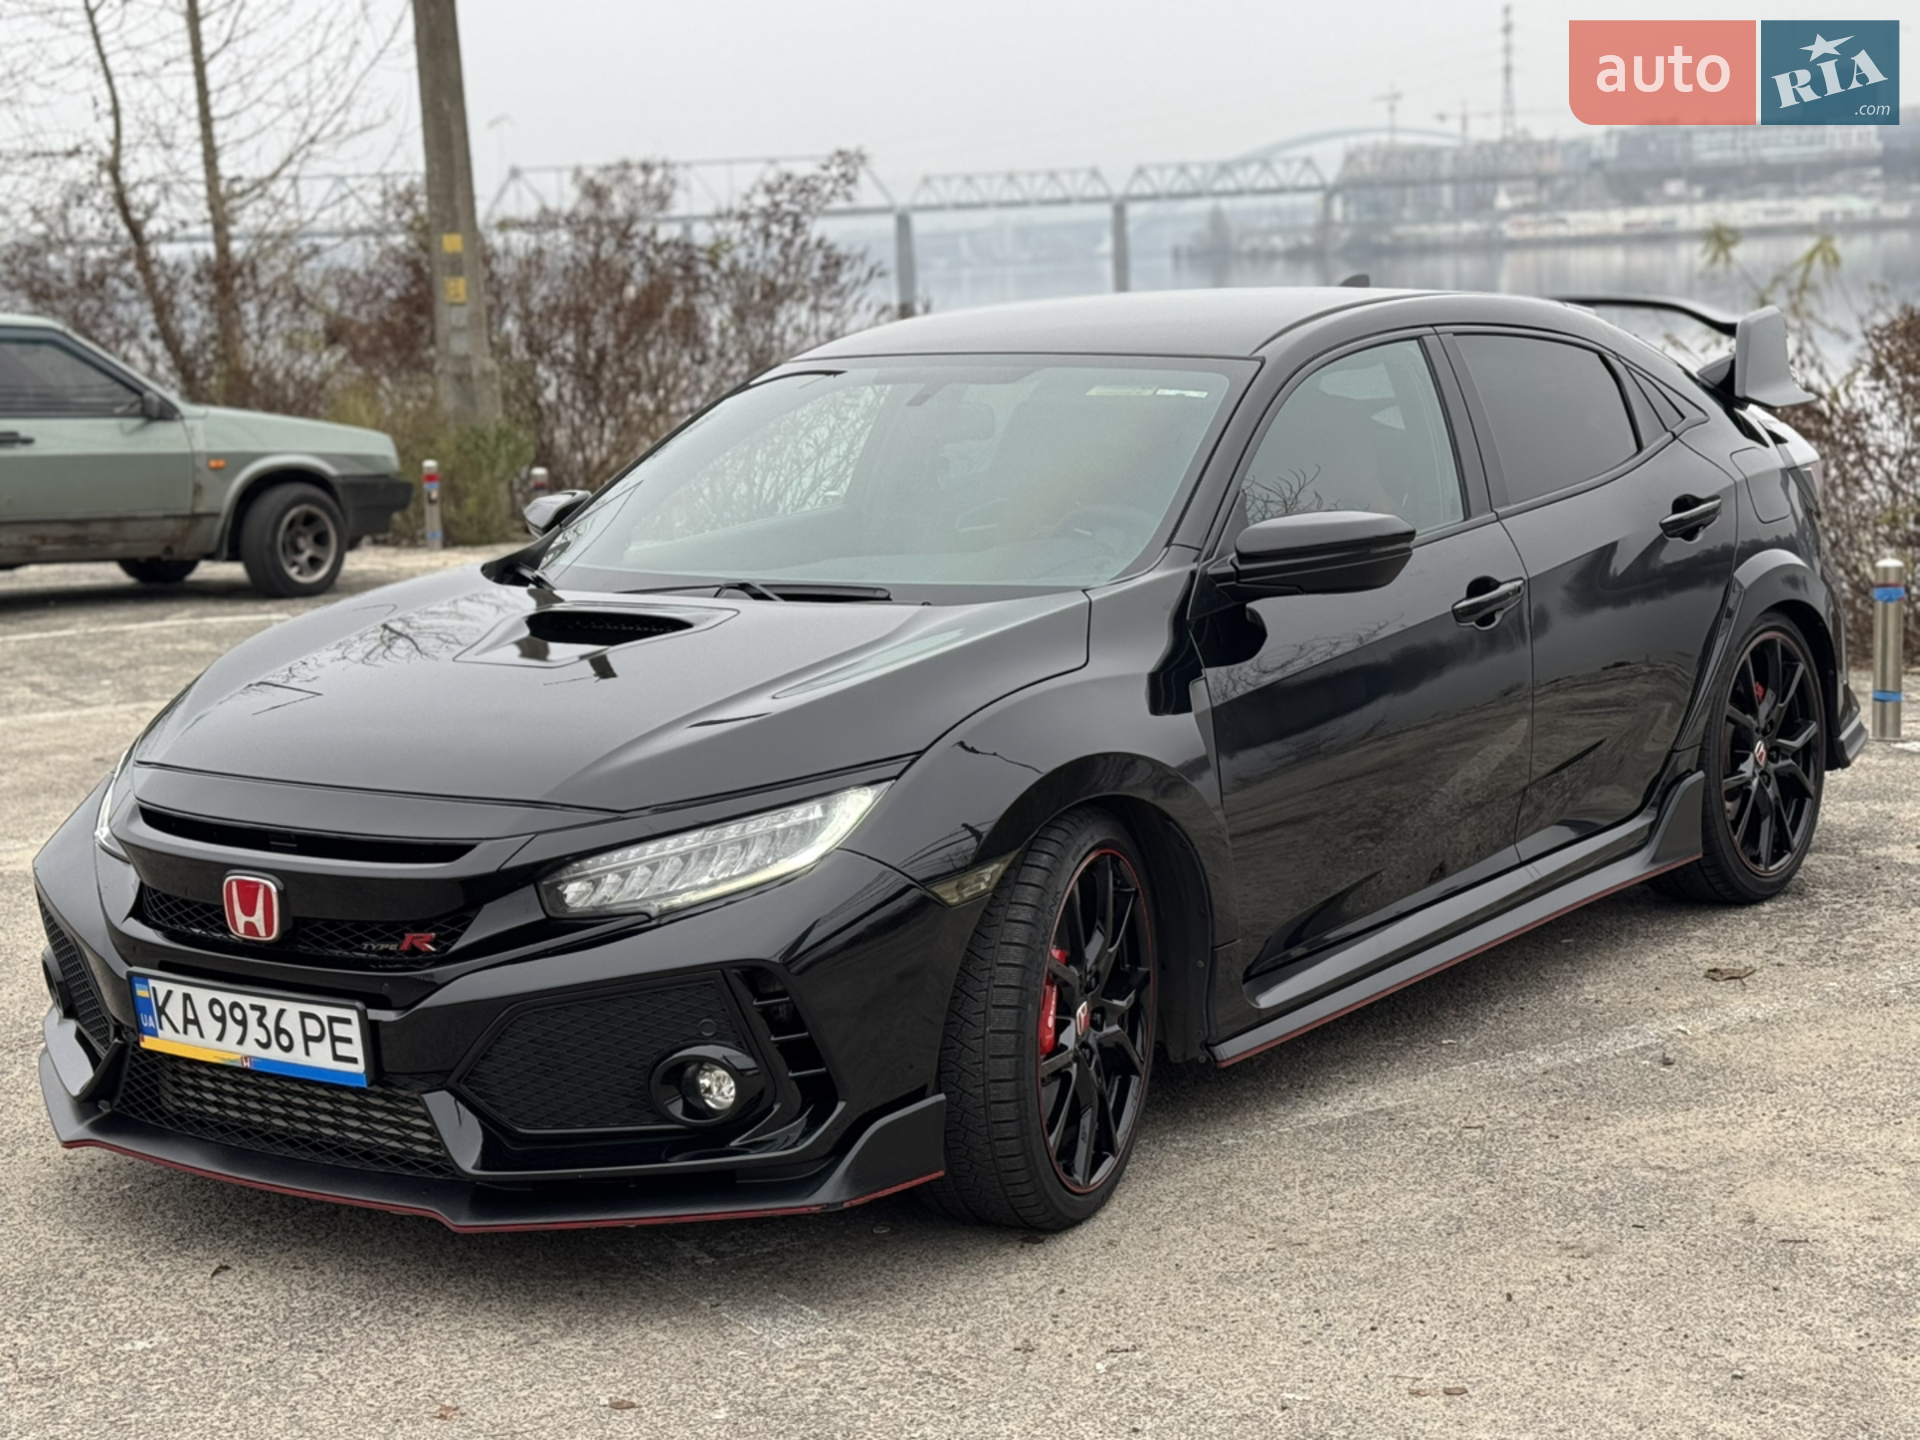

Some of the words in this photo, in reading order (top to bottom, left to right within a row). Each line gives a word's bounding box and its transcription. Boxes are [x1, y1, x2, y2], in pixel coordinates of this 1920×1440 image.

[362, 943, 399, 951] TYPE
[400, 932, 436, 952] R
[140, 1012, 156, 1029] UA
